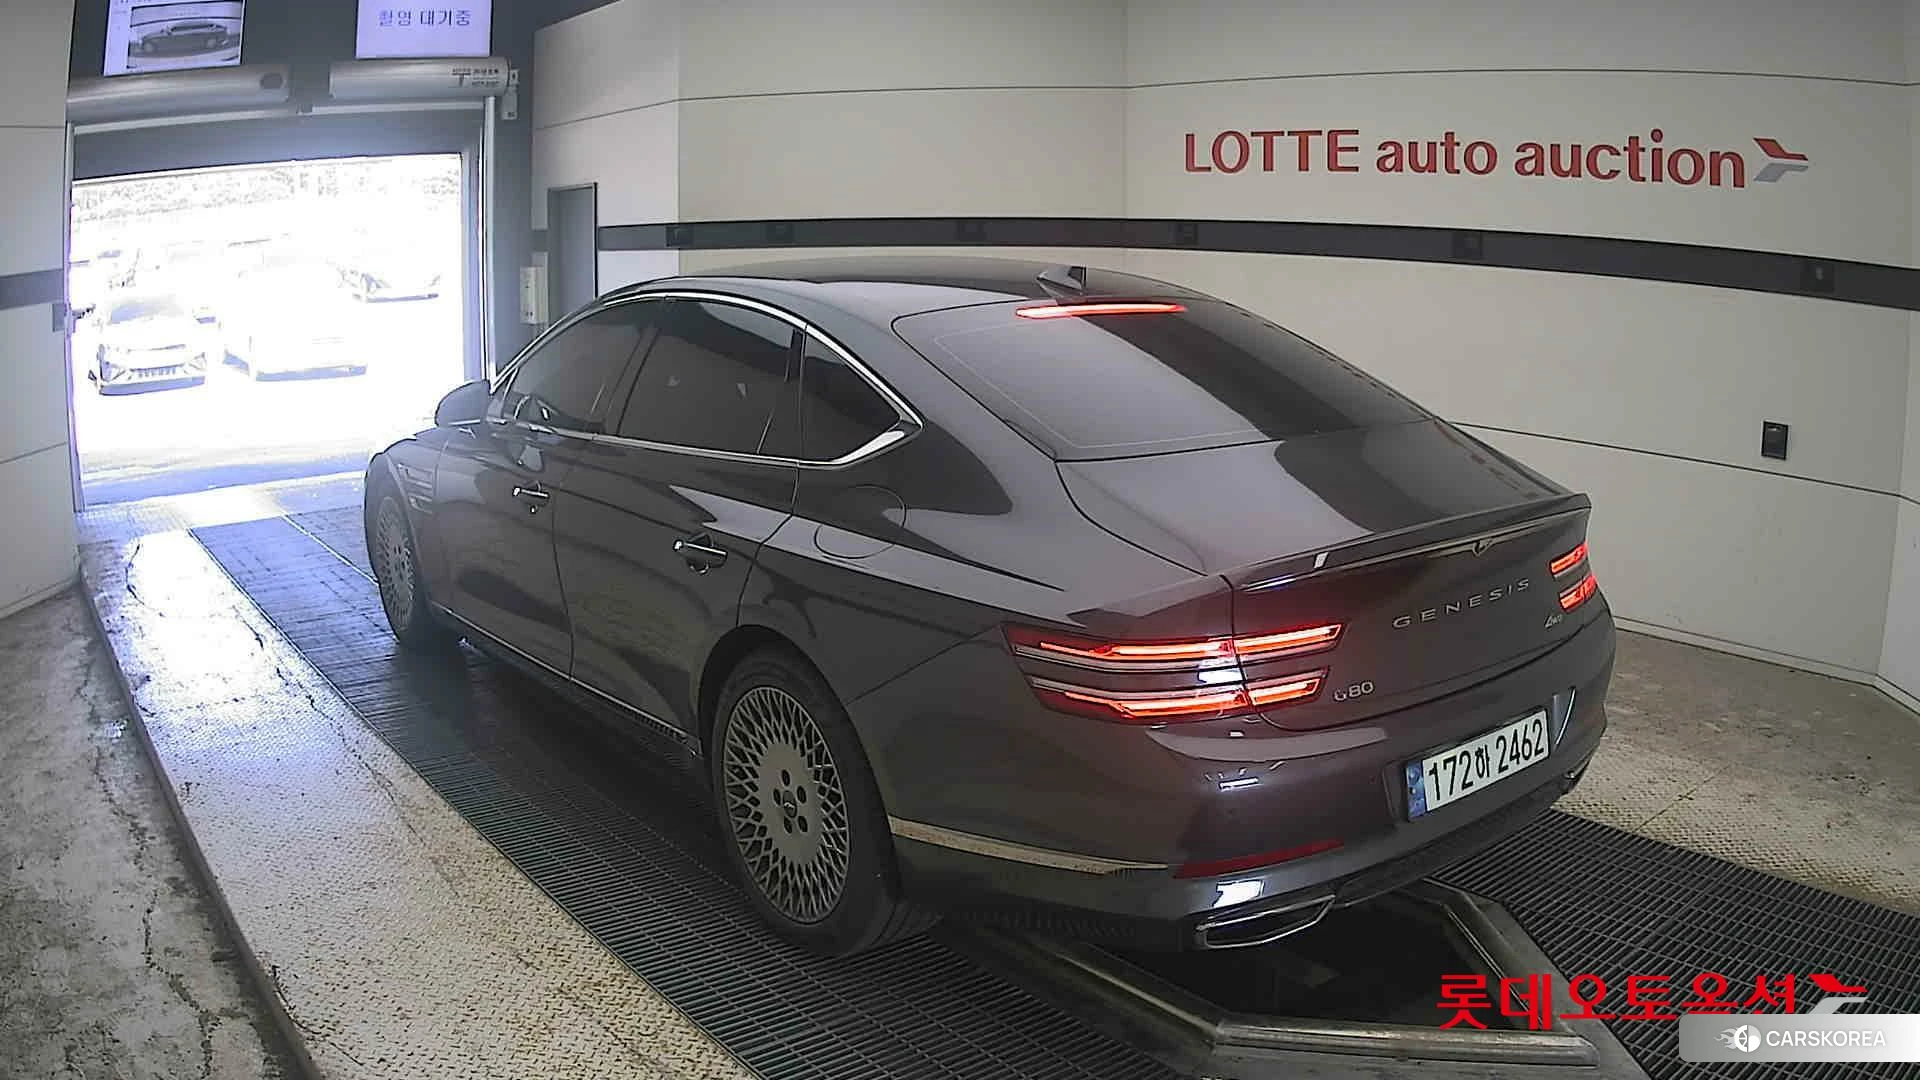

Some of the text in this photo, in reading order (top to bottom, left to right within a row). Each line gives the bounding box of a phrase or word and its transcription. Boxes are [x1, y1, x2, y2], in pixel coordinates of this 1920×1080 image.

[419, 9, 471, 26] 대기중
[1185, 128, 1746, 188] LOTTE auto auction
[1392, 578, 1530, 629] GENESIS
[1334, 681, 1374, 701] G80
[1428, 718, 1545, 801] 172하 2462
